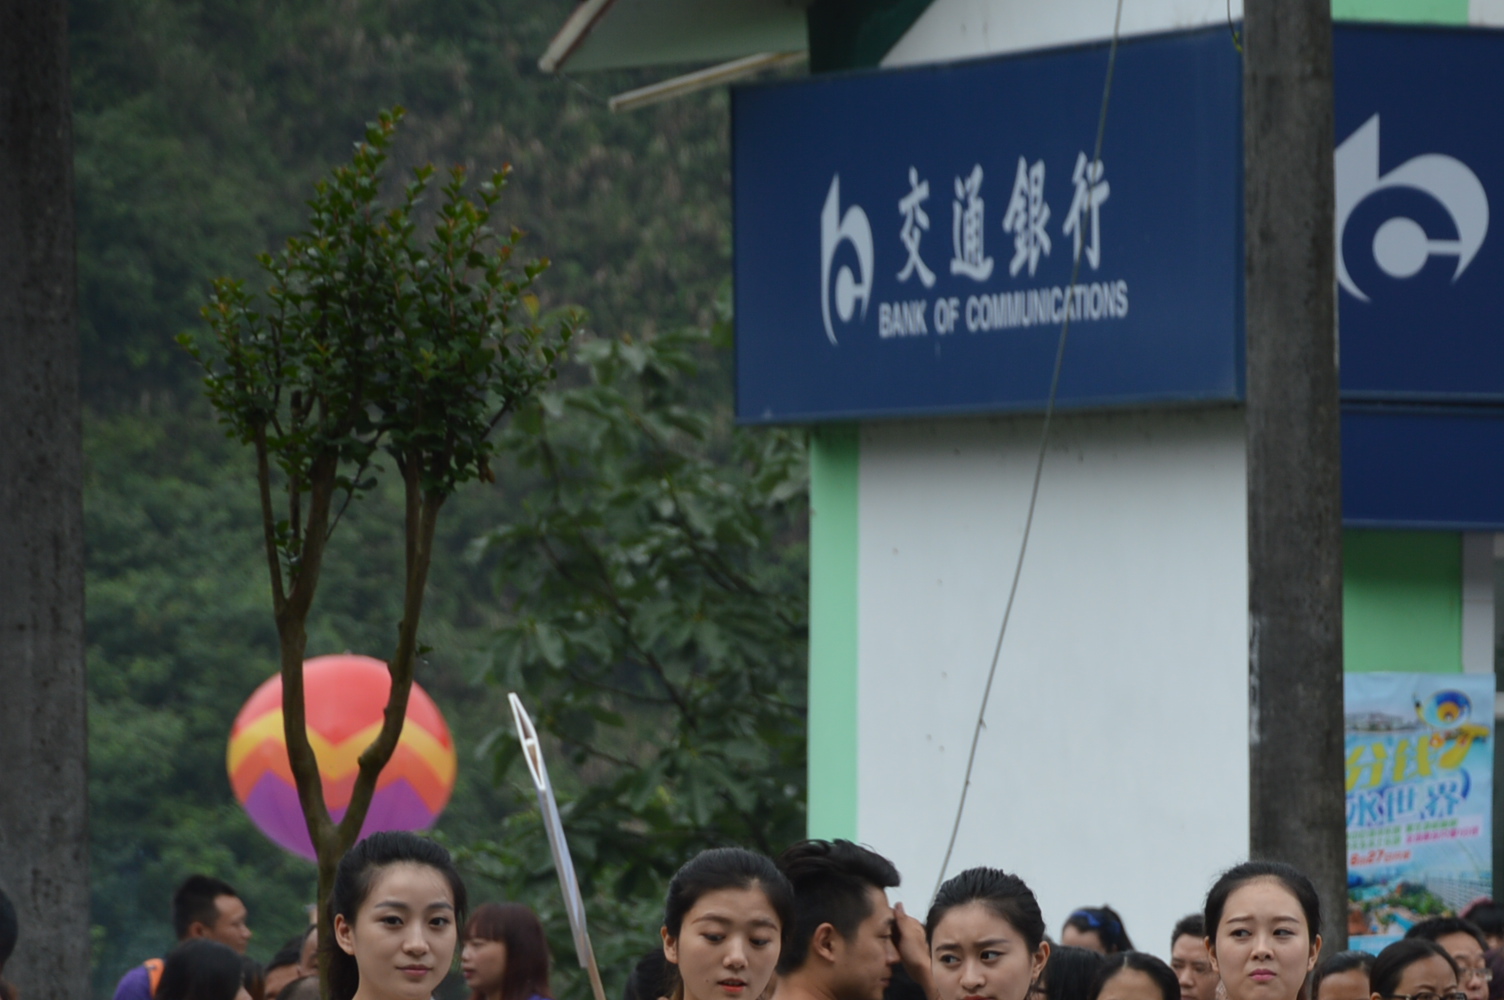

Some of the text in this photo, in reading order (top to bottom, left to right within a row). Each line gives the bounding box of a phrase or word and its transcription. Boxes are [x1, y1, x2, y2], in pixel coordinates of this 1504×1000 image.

[897, 151, 1110, 287] 交通銀行
[878, 280, 1128, 340] BANK OF COMMUNICATIONS
